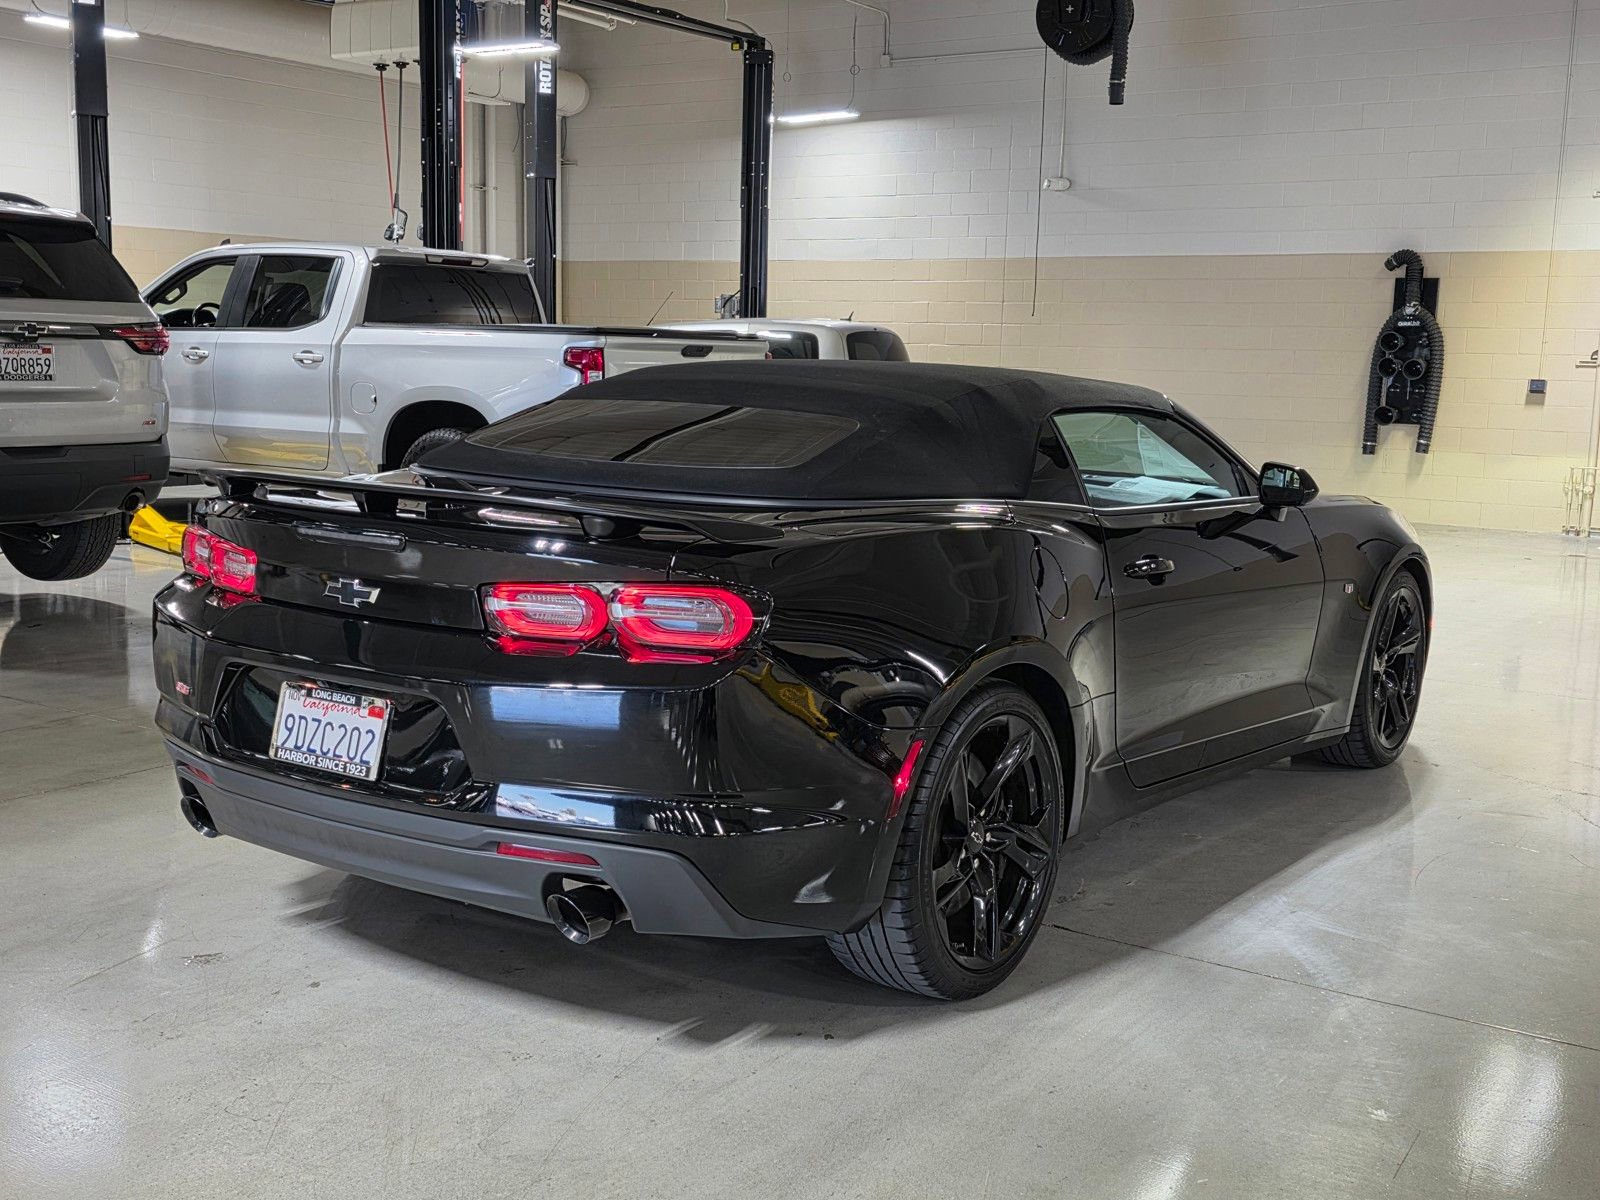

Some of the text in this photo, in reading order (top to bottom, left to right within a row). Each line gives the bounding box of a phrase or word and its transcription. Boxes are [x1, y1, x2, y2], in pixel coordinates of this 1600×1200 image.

[539, 27, 552, 93] ROTAY
[2, 348, 42, 357] California
[312, 688, 356, 705] LONG BEACH
[281, 713, 376, 765] 9DZC202
[277, 748, 367, 777] HARBOR SINCE 1923
